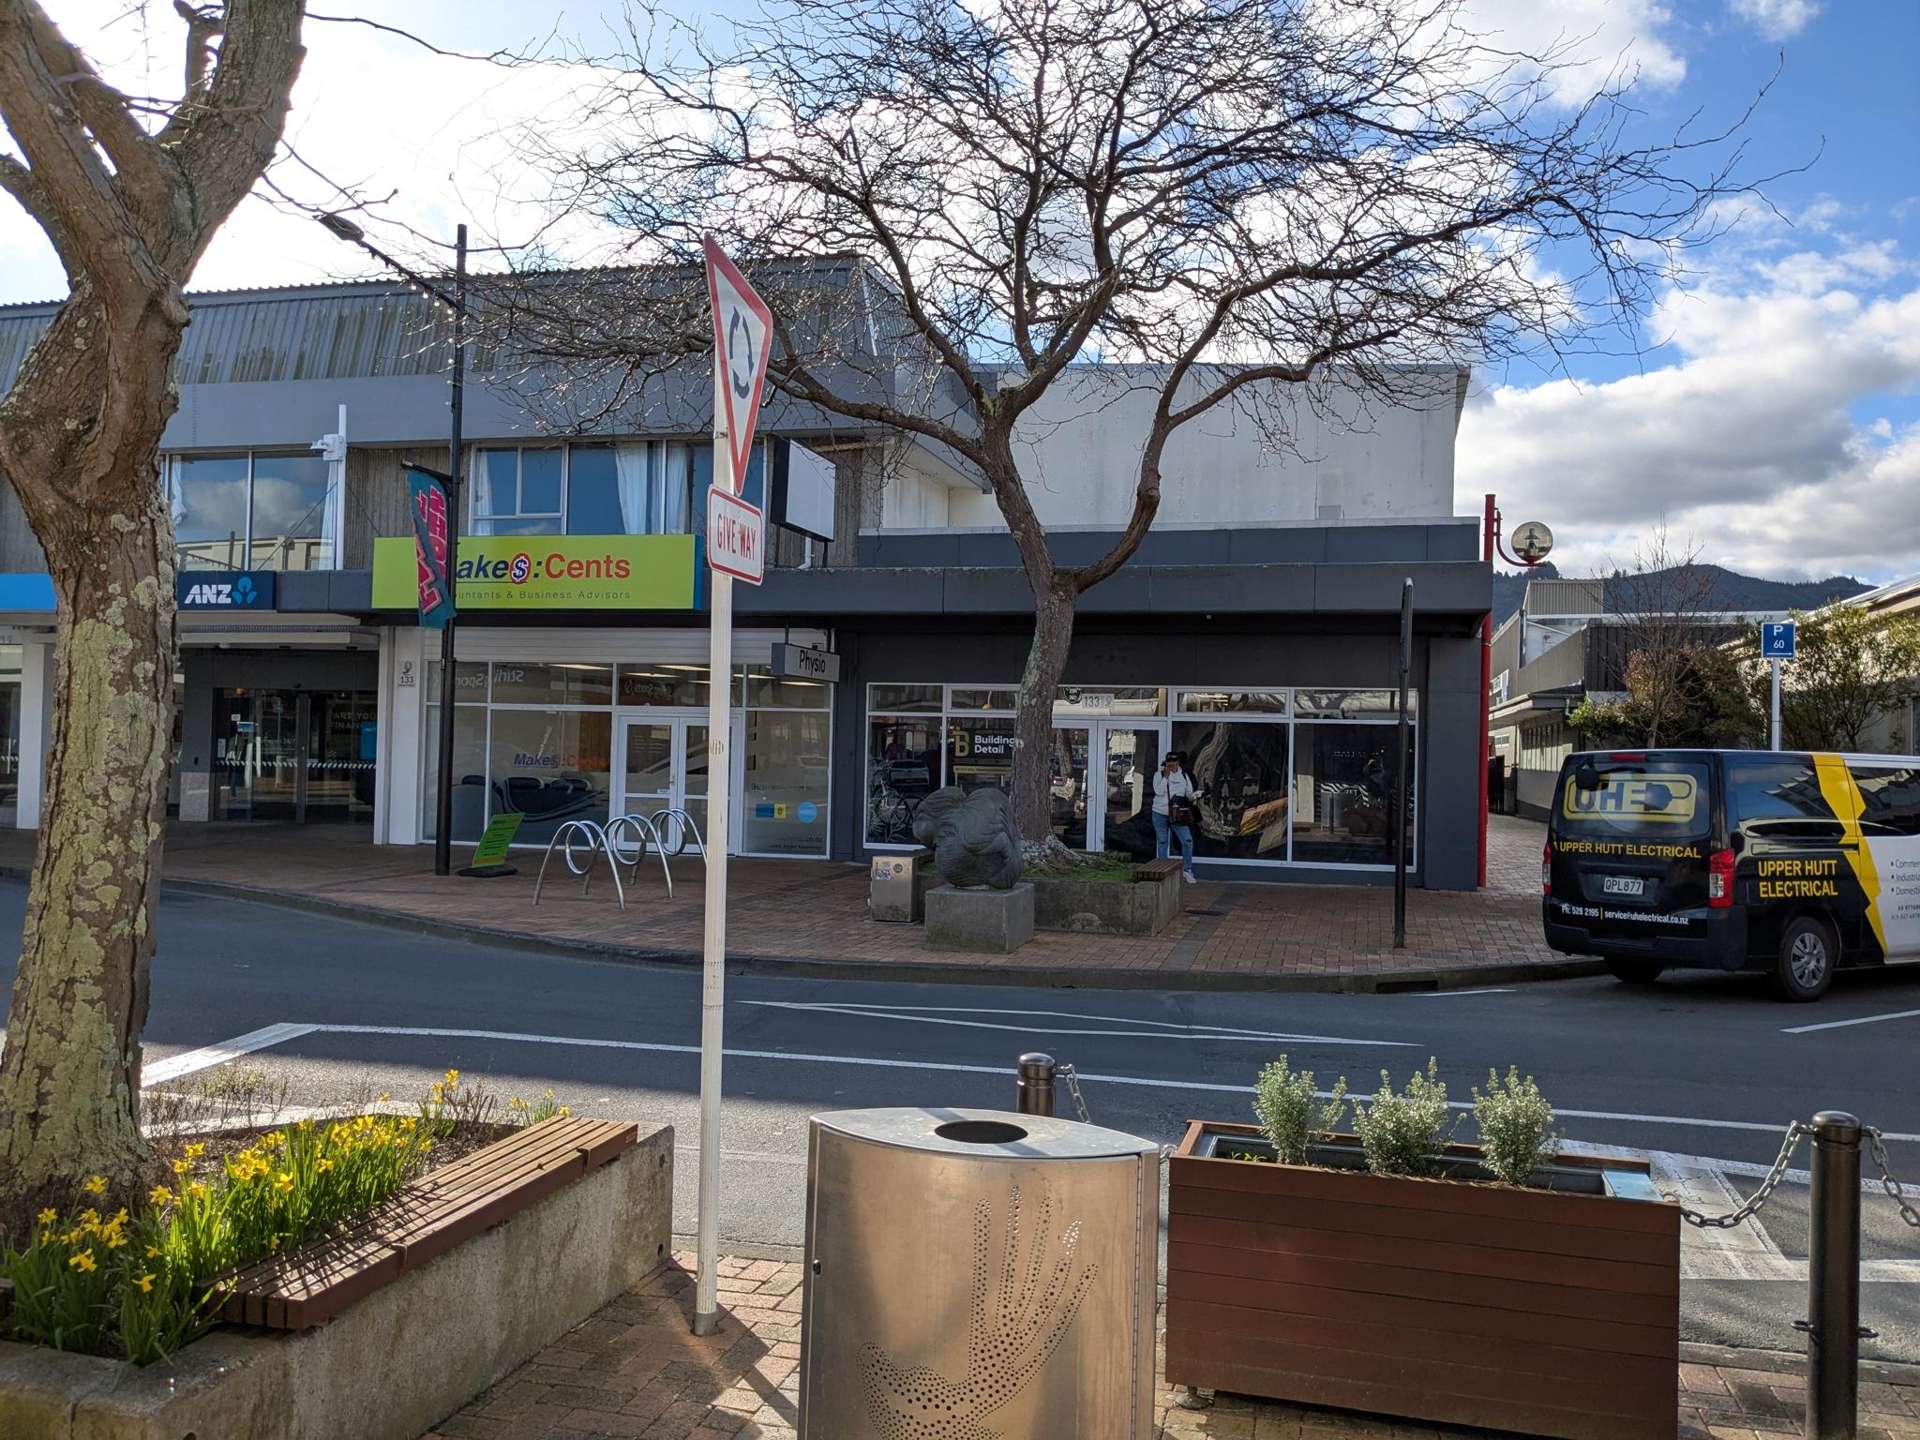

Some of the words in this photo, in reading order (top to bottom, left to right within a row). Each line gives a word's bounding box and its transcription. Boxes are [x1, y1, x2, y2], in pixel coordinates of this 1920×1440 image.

[717, 513, 736, 554] GIVE
[737, 522, 757, 561] WAY
[184, 584, 232, 604] ANZ
[506, 591, 513, 600] &
[519, 591, 573, 600] Business
[578, 591, 631, 600] Advisors
[1773, 625, 1784, 637] P
[1773, 640, 1785, 649] 60
[799, 649, 826, 674] Physio
[974, 735, 1015, 748] Building
[974, 744, 1005, 754] Detail
[1560, 841, 1592, 853] UPPER
[1595, 843, 1624, 855] HUTT
[1626, 844, 1702, 858] ELECTRICAL
[1758, 860, 1802, 877] UPPER
[1805, 860, 1838, 876] HUTT
[1605, 879, 1643, 893] QPL877
[1759, 880, 1839, 898] ELECTRICAL
[1571, 906, 1583, 916] 528
[1584, 907, 1600, 918] 2195
[1604, 910, 1689, 926] service@uhelectrical.co.nz
